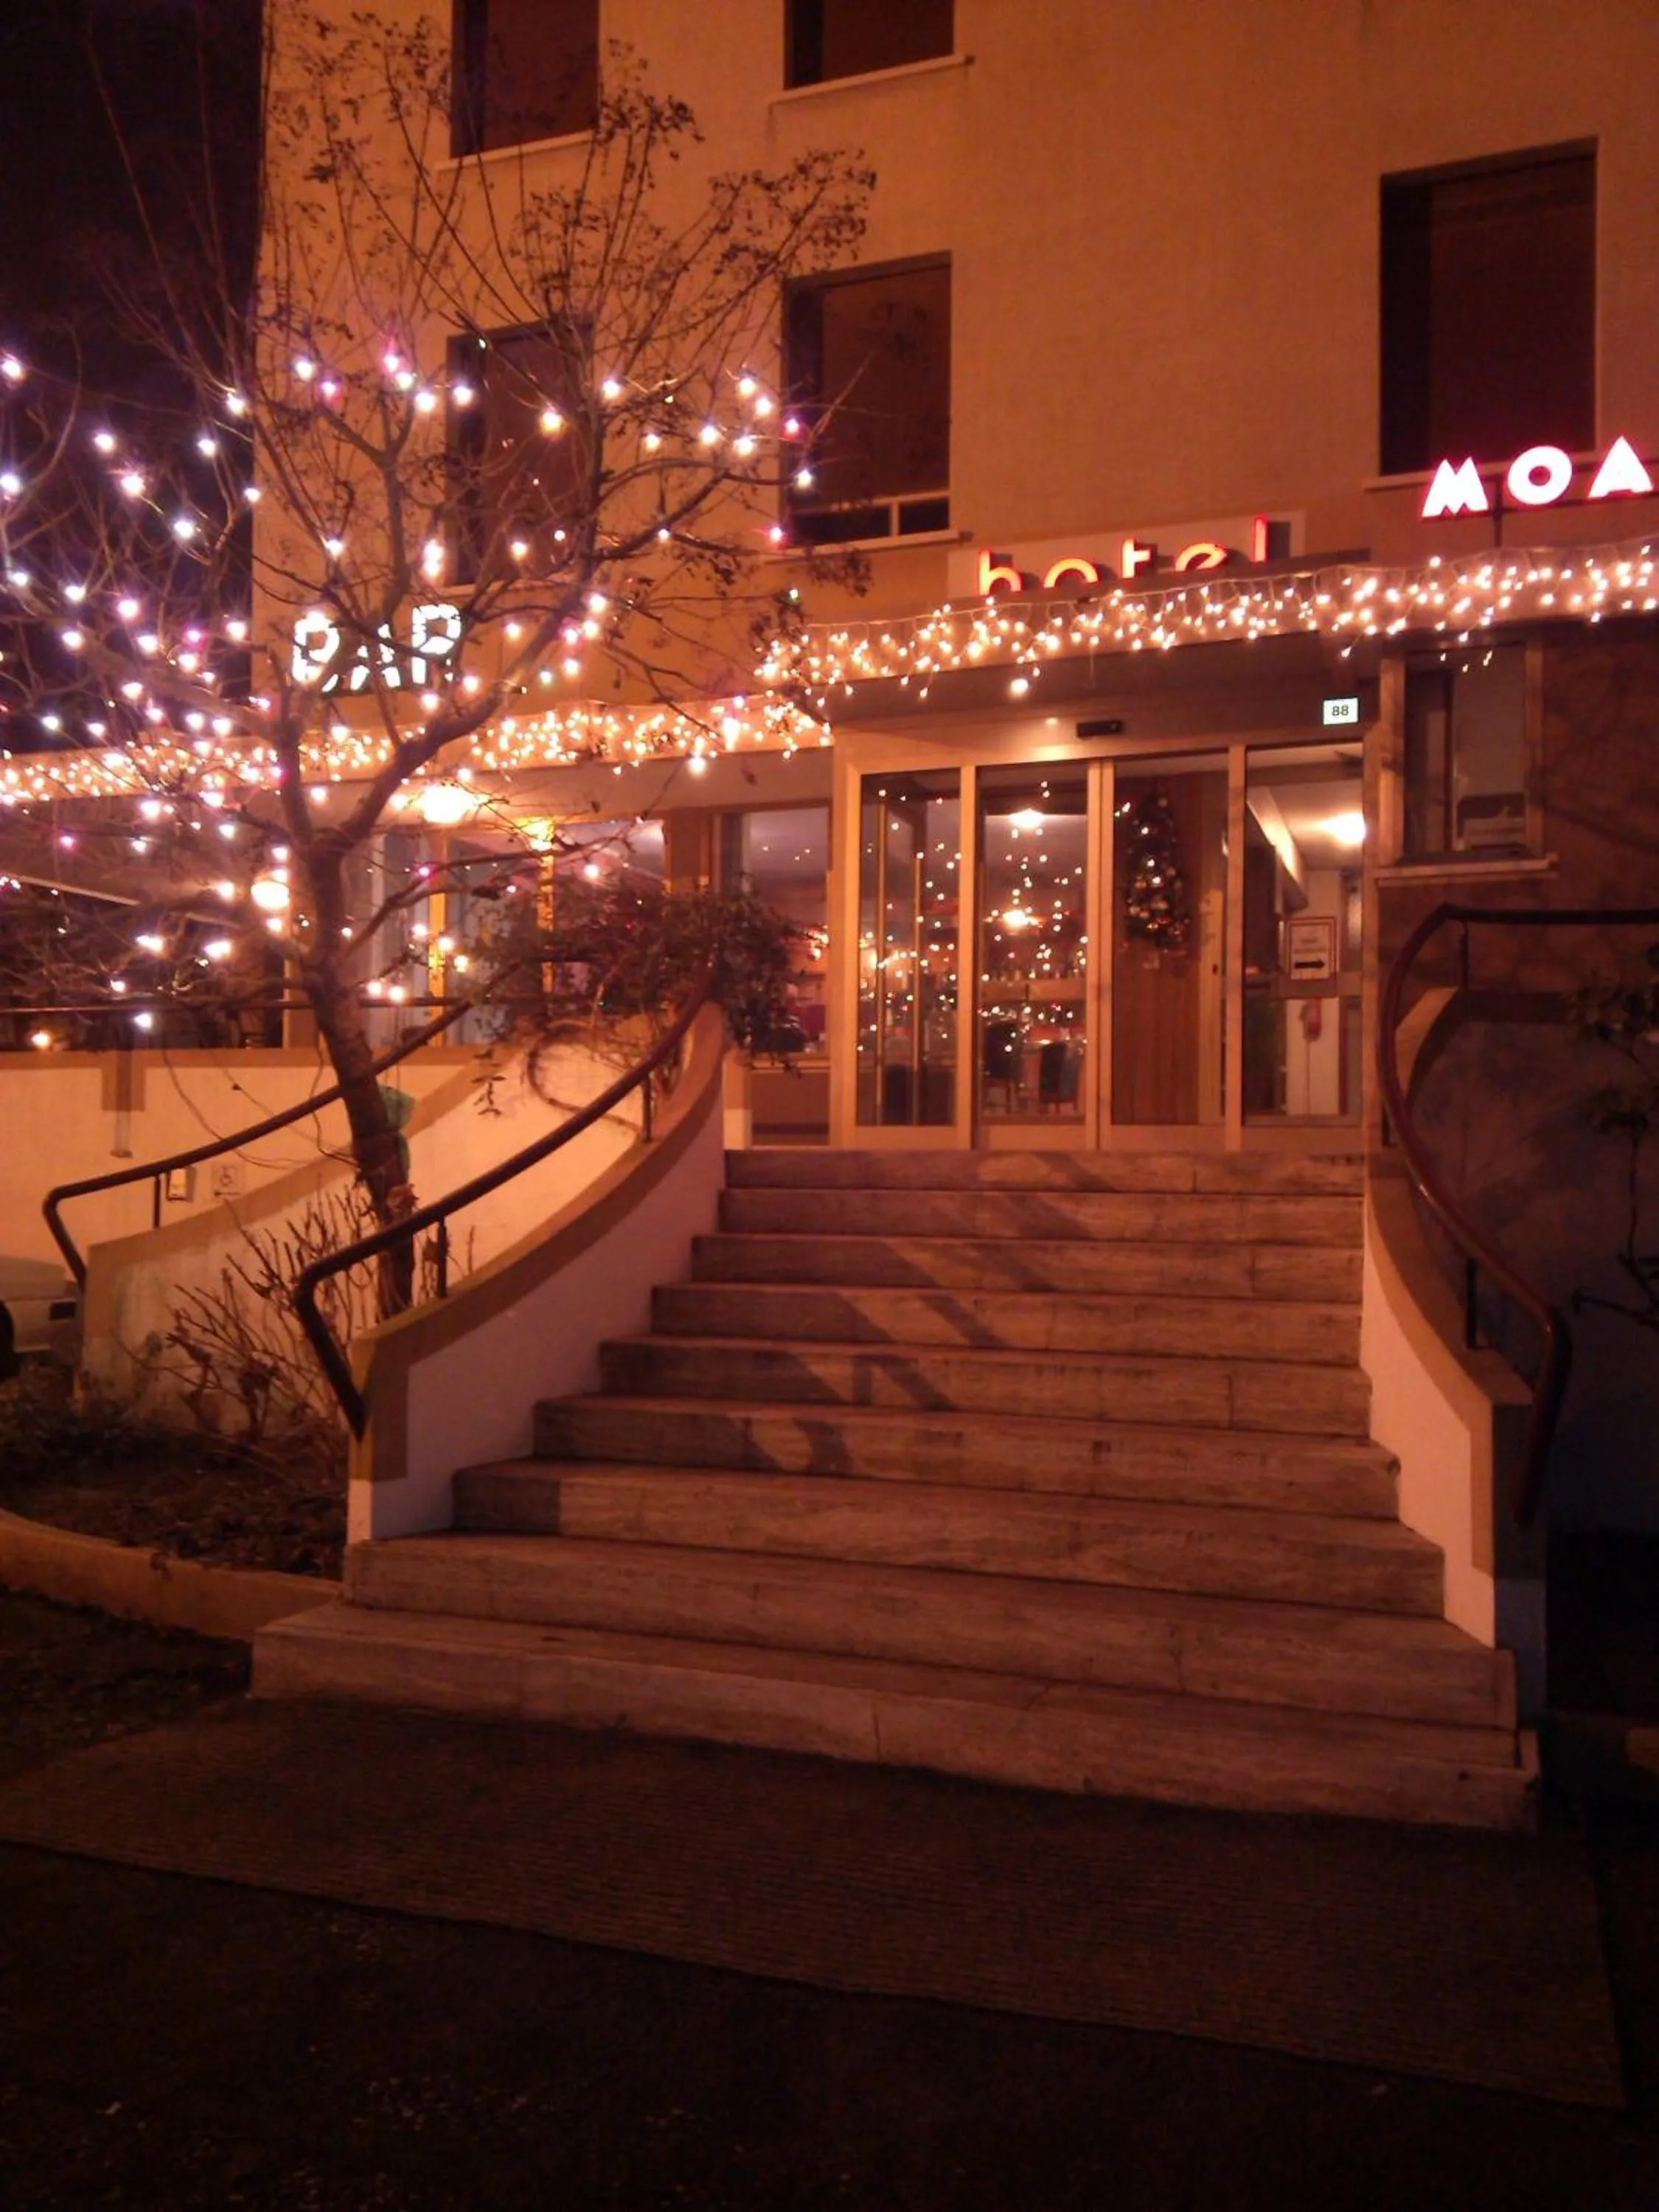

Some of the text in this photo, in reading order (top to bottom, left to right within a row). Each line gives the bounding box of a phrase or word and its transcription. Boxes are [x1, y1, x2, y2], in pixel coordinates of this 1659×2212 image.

[1421, 434, 1654, 518] MOA
[978, 516, 1268, 596] hotel
[1332, 705, 1349, 717] 88
